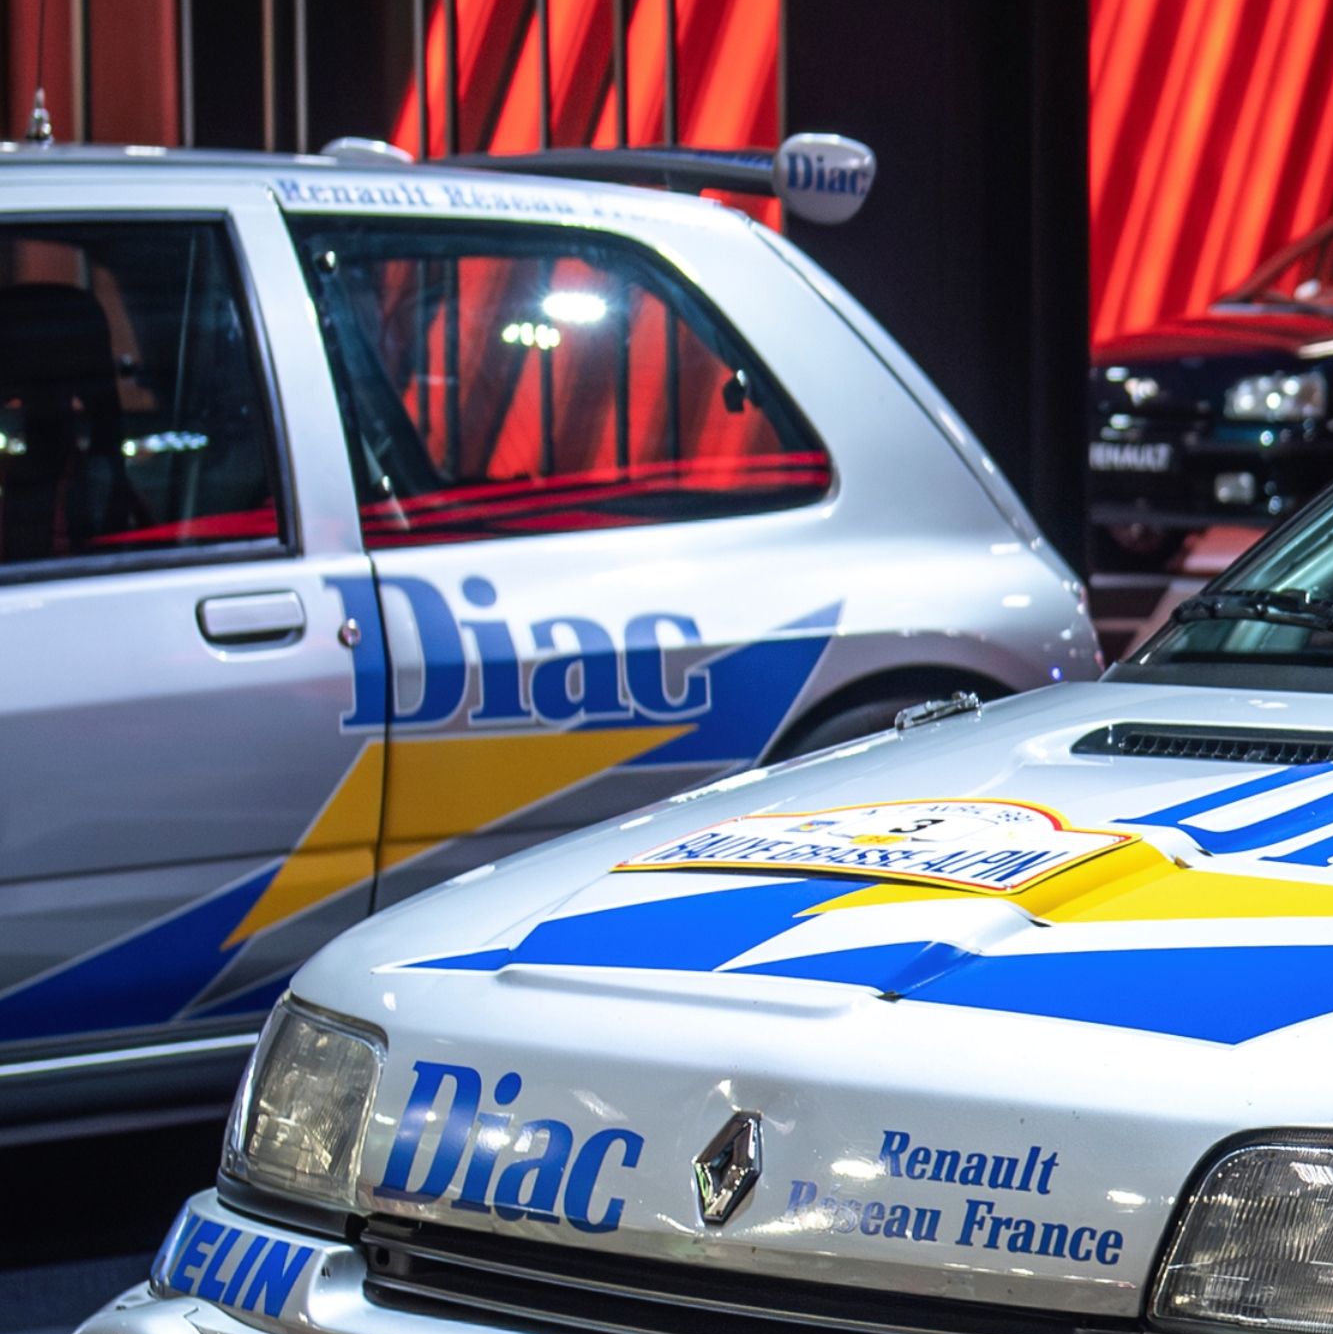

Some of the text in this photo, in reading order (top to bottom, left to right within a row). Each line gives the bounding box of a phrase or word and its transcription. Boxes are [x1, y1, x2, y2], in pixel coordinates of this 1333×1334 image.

[275, 178, 433, 208] Renault
[786, 151, 869, 196] Diac
[322, 575, 711, 732] Diac
[643, 833, 1068, 883] RALLYE GRASSE ALPIN
[373, 1060, 646, 1234] Diac
[879, 1129, 1060, 1195] Renault
[955, 1199, 1125, 1266] France
